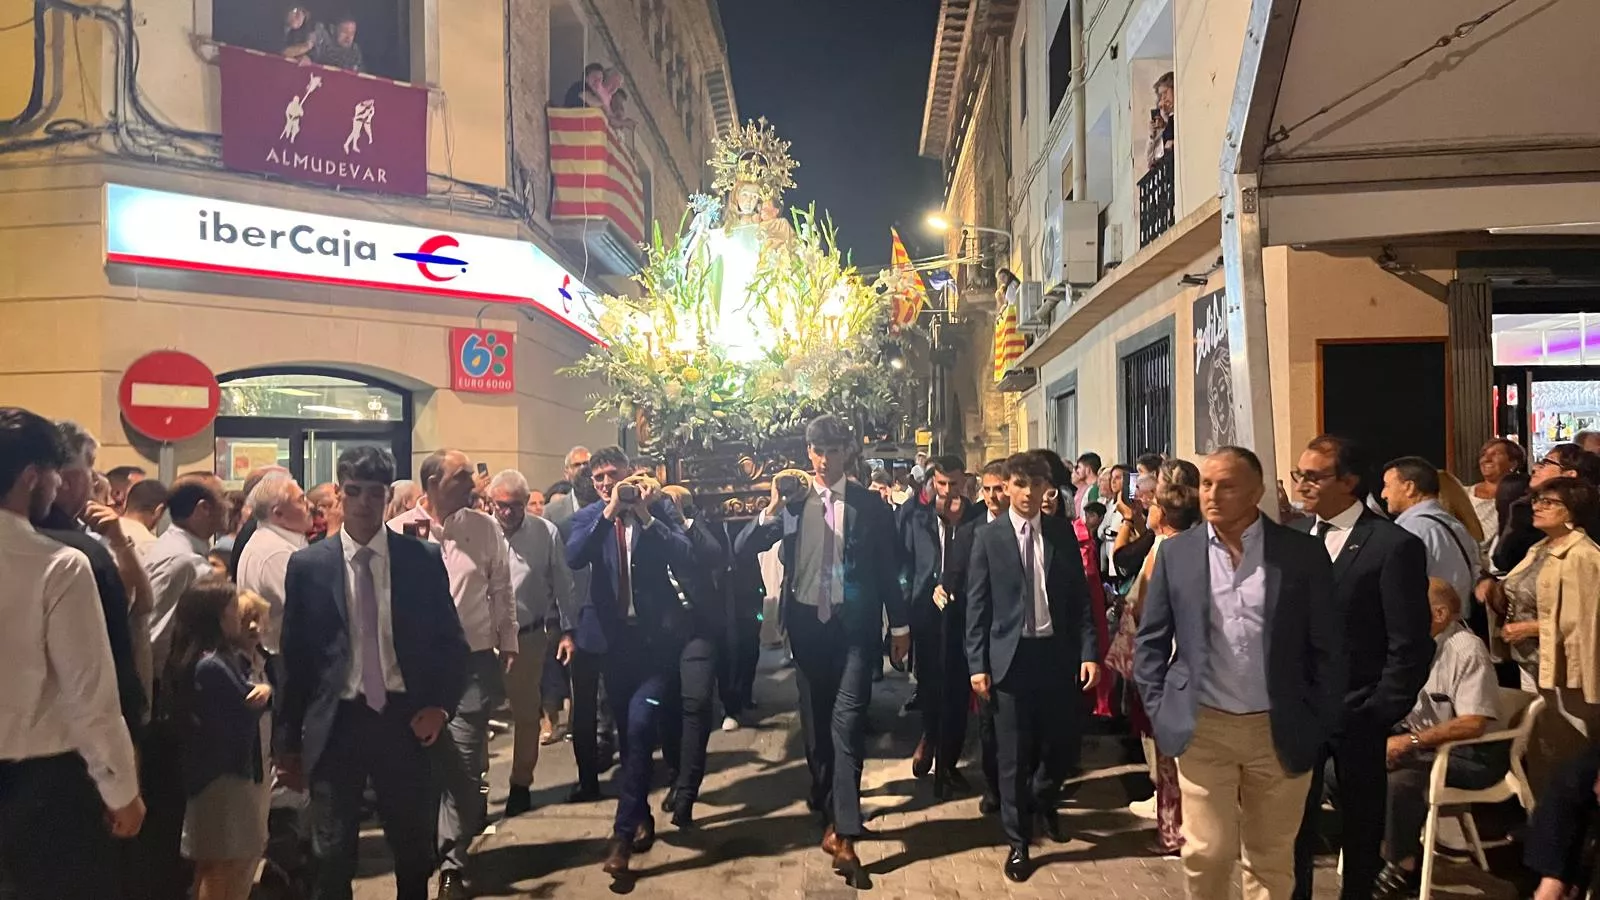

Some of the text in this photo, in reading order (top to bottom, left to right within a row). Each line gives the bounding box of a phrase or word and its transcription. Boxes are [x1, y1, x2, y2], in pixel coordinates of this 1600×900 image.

[266, 147, 387, 183] ALMUDEVAR
[199, 209, 376, 267] iberCaja
[458, 377, 512, 390] EURO 6000
